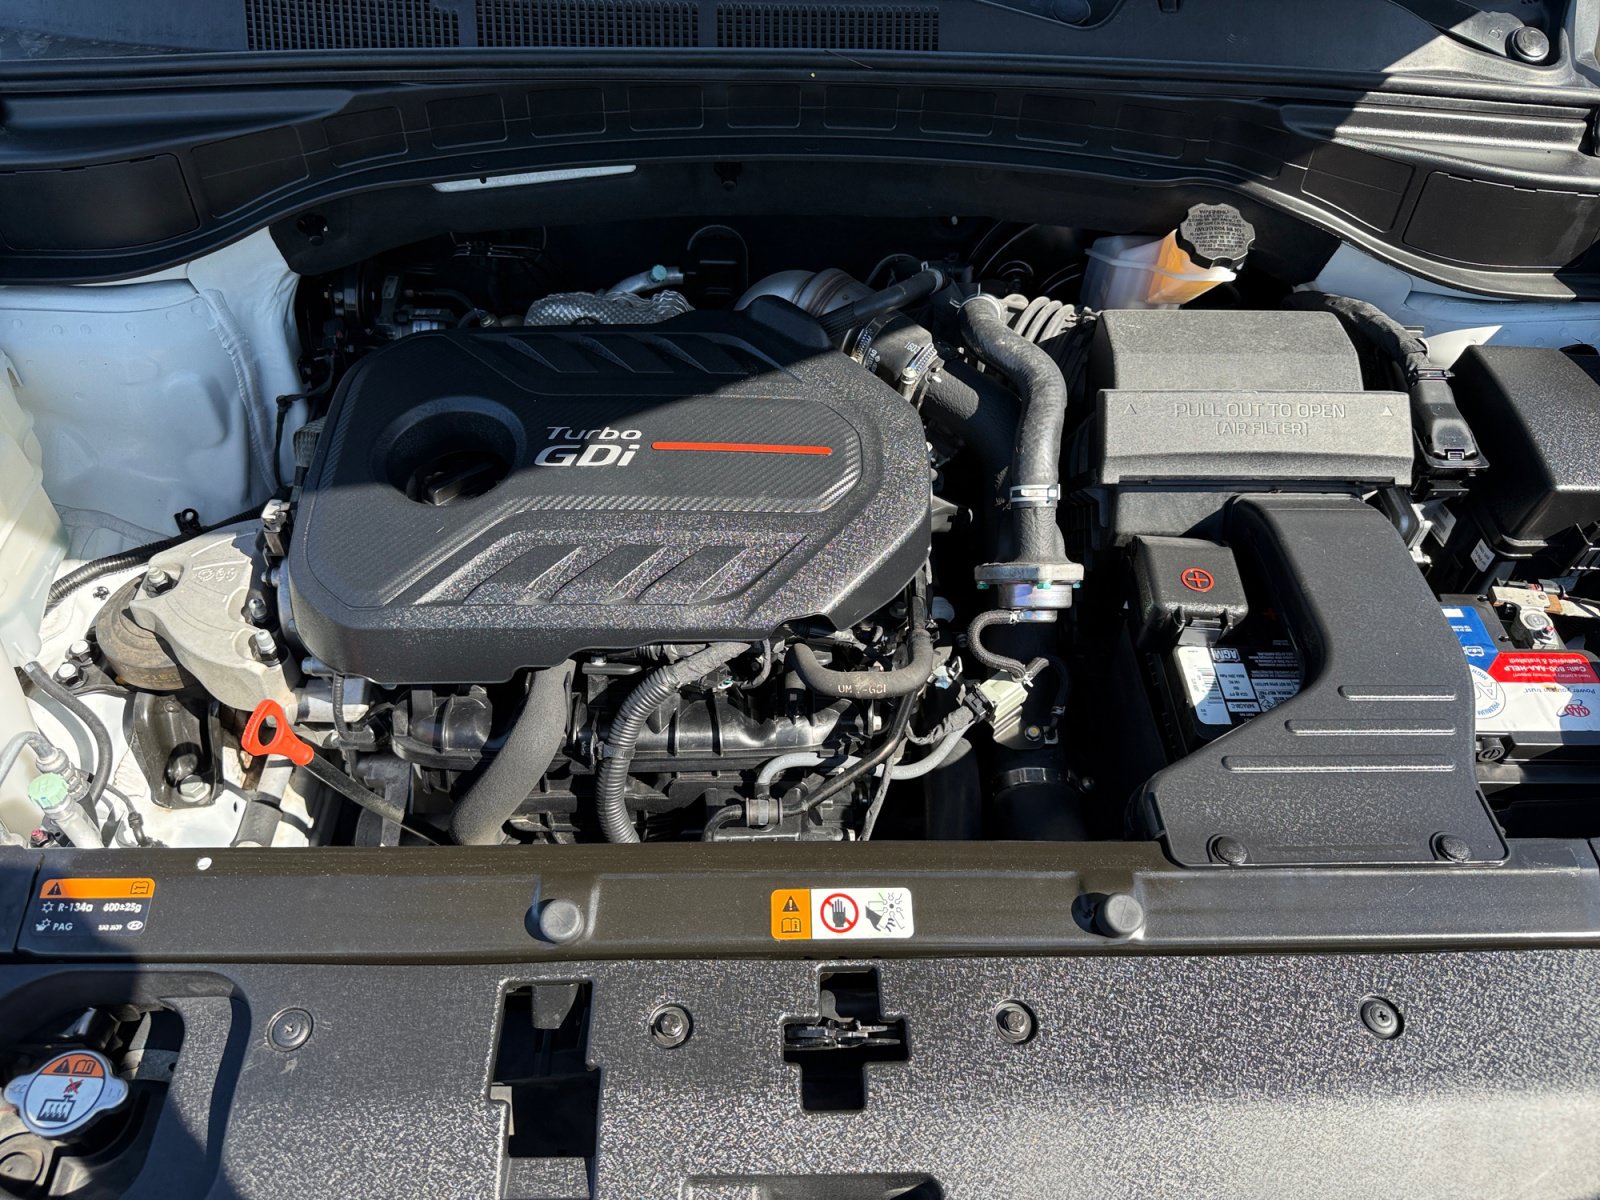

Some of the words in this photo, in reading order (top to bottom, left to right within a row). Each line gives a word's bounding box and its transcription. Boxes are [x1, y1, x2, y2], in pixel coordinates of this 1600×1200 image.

[1174, 402, 1222, 418] PULL
[1227, 402, 1265, 418] OUT
[1270, 402, 1293, 418] TO
[1298, 403, 1346, 419] OPEN
[547, 426, 642, 440] Turbo
[534, 444, 641, 467] GDi
[1213, 649, 1237, 660] AGM
[1471, 668, 1489, 681] HIGH
[1477, 701, 1501, 716] PREMIUM
[57, 902, 94, 912] R-134a
[103, 902, 142, 913] 600±25g
[52, 922, 73, 931] PAG
